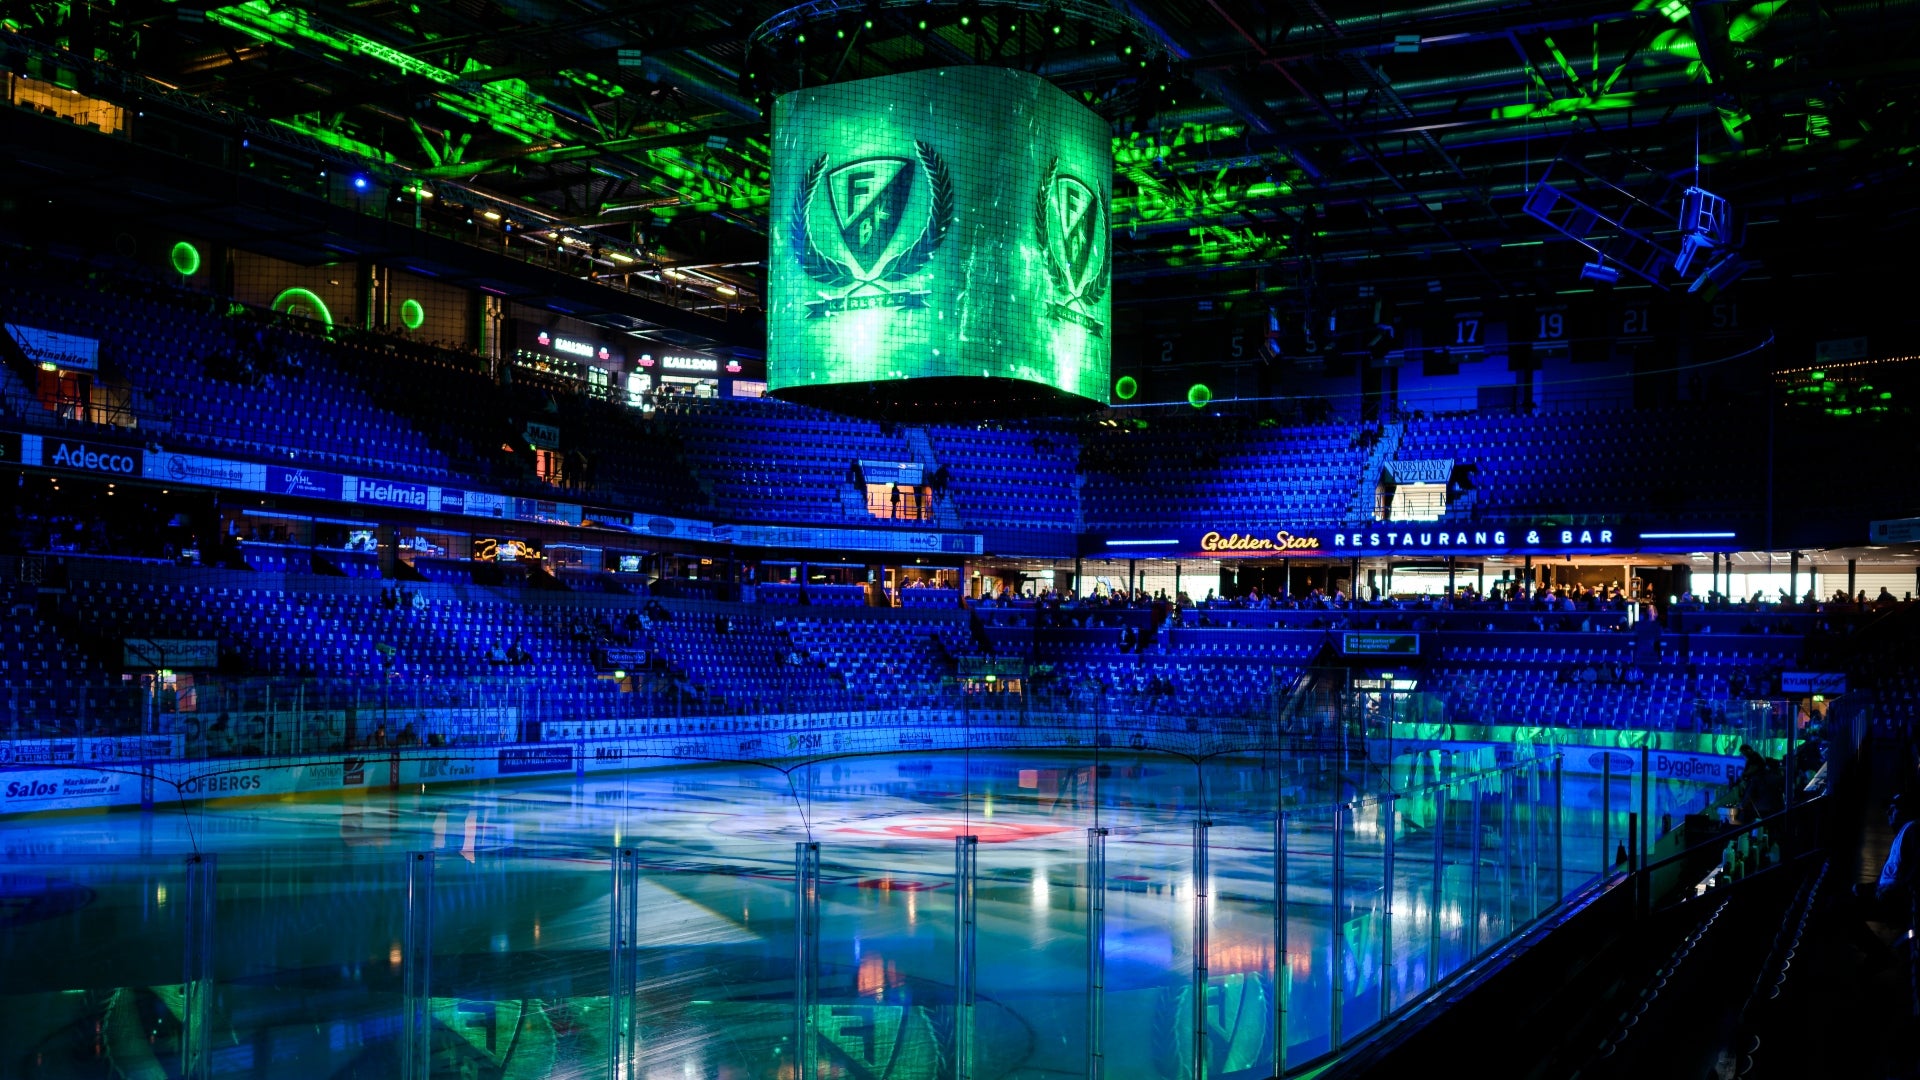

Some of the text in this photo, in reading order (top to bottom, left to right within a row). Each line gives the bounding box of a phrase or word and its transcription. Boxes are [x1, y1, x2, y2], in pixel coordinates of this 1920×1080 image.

[1455, 319, 1480, 344] 17
[1537, 311, 1565, 339] 19
[1622, 309, 1649, 334] 21
[1160, 339, 1175, 363] 2
[1231, 335, 1244, 358] 5
[530, 425, 557, 442] MAXI
[52, 442, 134, 474] Adecco
[1392, 460, 1446, 471] NORRSTRANDS
[285, 472, 313, 486] DAHL
[359, 480, 426, 506] Helmia
[1200, 530, 1320, 551] Golden Star
[1334, 529, 1614, 547] RESTAURANG & BAR
[799, 733, 822, 749] PSM
[596, 747, 623, 760] MAXI
[1657, 755, 1721, 778] ByggTema
[5, 780, 58, 798] Salos
